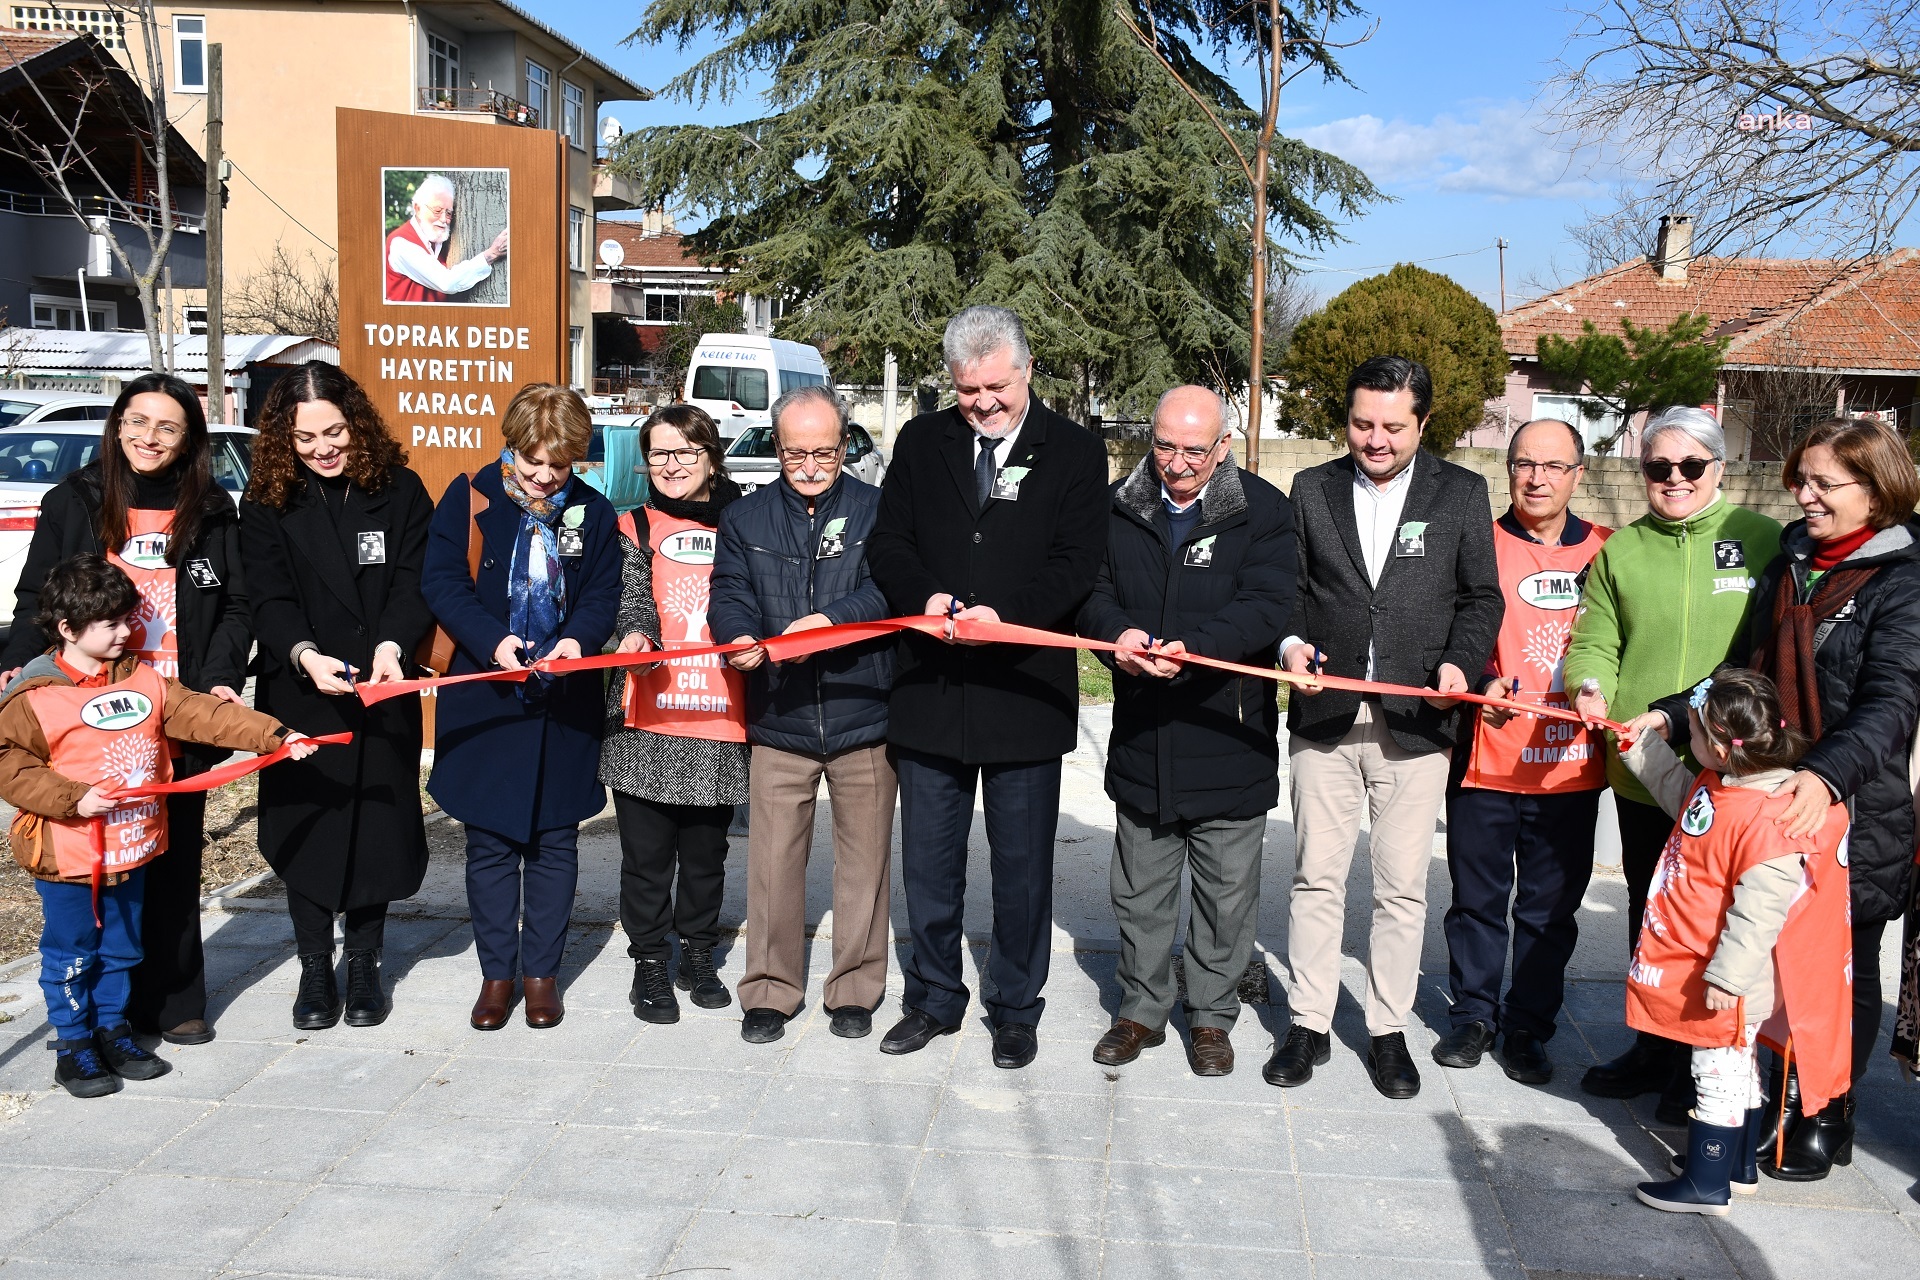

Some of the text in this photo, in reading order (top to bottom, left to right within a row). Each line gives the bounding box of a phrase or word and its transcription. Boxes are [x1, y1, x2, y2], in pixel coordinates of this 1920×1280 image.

[364, 324, 530, 350] TOPRAK DEDE
[381, 356, 513, 383] HAYRETTİN
[398, 391, 496, 416] KARACA
[412, 425, 482, 449] PARKI
[136, 540, 166, 556] TEM
[675, 536, 712, 551] TEMA
[1534, 578, 1572, 594] TEMA
[1712, 576, 1748, 590] TEMA
[677, 669, 709, 692] ÇÖL
[92, 697, 135, 718] TEMA
[656, 693, 728, 713] OLMASIN
[1544, 720, 1576, 744] ÇÖL
[1521, 743, 1595, 764] OLMASIN
[119, 822, 146, 848] ÇÖL
